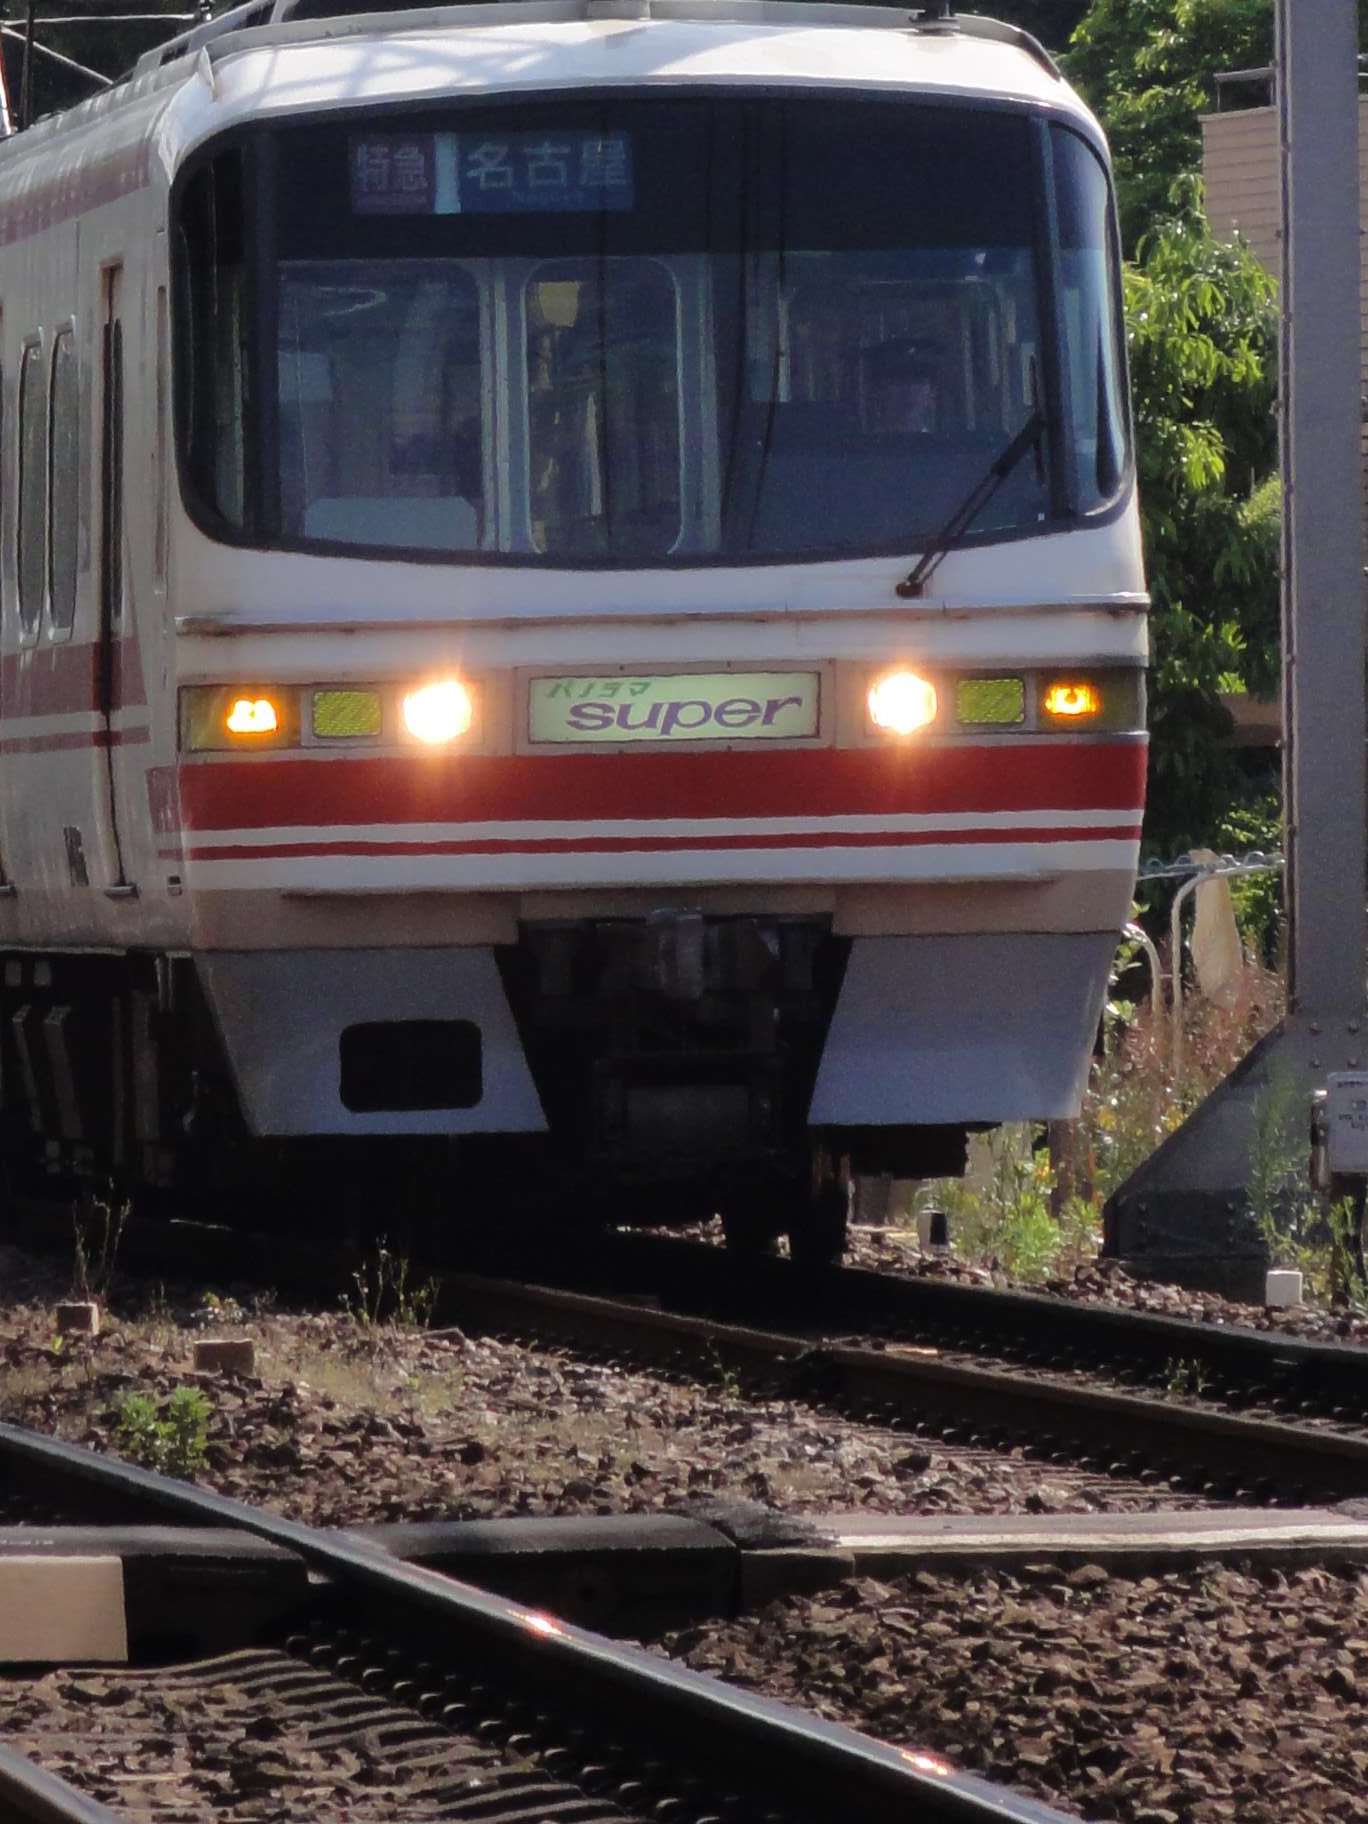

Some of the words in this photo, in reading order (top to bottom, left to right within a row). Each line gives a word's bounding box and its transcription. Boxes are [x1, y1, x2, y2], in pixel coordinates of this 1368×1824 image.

[357, 143, 428, 192] 特急
[466, 140, 628, 190] 名古屋
[565, 696, 803, 736] super
